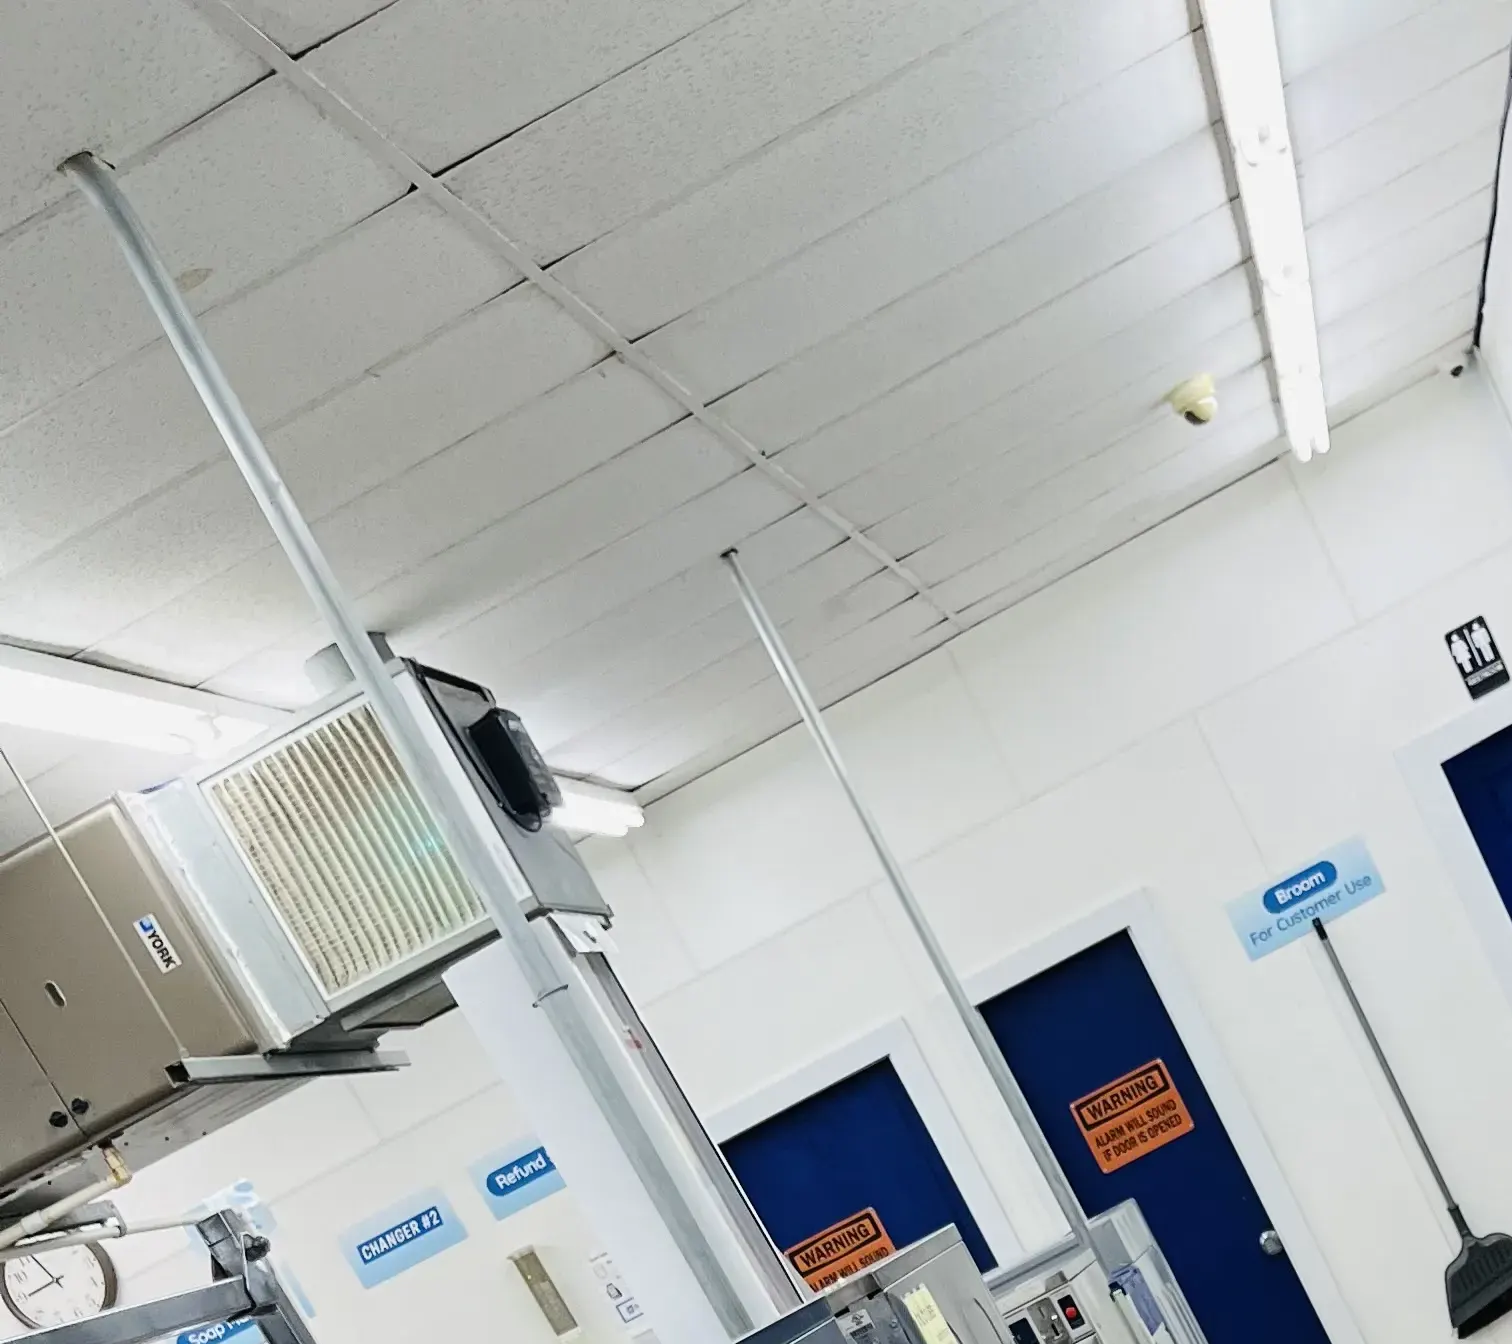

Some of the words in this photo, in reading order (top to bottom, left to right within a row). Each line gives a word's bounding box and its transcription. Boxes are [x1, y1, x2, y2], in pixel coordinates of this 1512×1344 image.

[1274, 871, 1326, 905] Broom
[1250, 925, 1273, 947] For
[1276, 889, 1342, 931] Customer
[1344, 875, 1372, 895] Use
[147, 929, 176, 968] YORK
[1087, 1075, 1159, 1121] WARNING
[1095, 1125, 1126, 1149] ALARM
[1124, 1114, 1148, 1133] WILL
[1145, 1099, 1177, 1122] SOUND
[1102, 1147, 1114, 1162] IF
[1113, 1135, 1138, 1157] DOOR
[1137, 1131, 1149, 1144] IS
[1147, 1114, 1182, 1139] OPENED
[495, 1154, 548, 1190] Refund
[361, 1219, 421, 1260] CHANGER
[421, 1210, 441, 1231] #2
[800, 1223, 871, 1268] WARNING
[860, 1246, 889, 1268] SOUND
